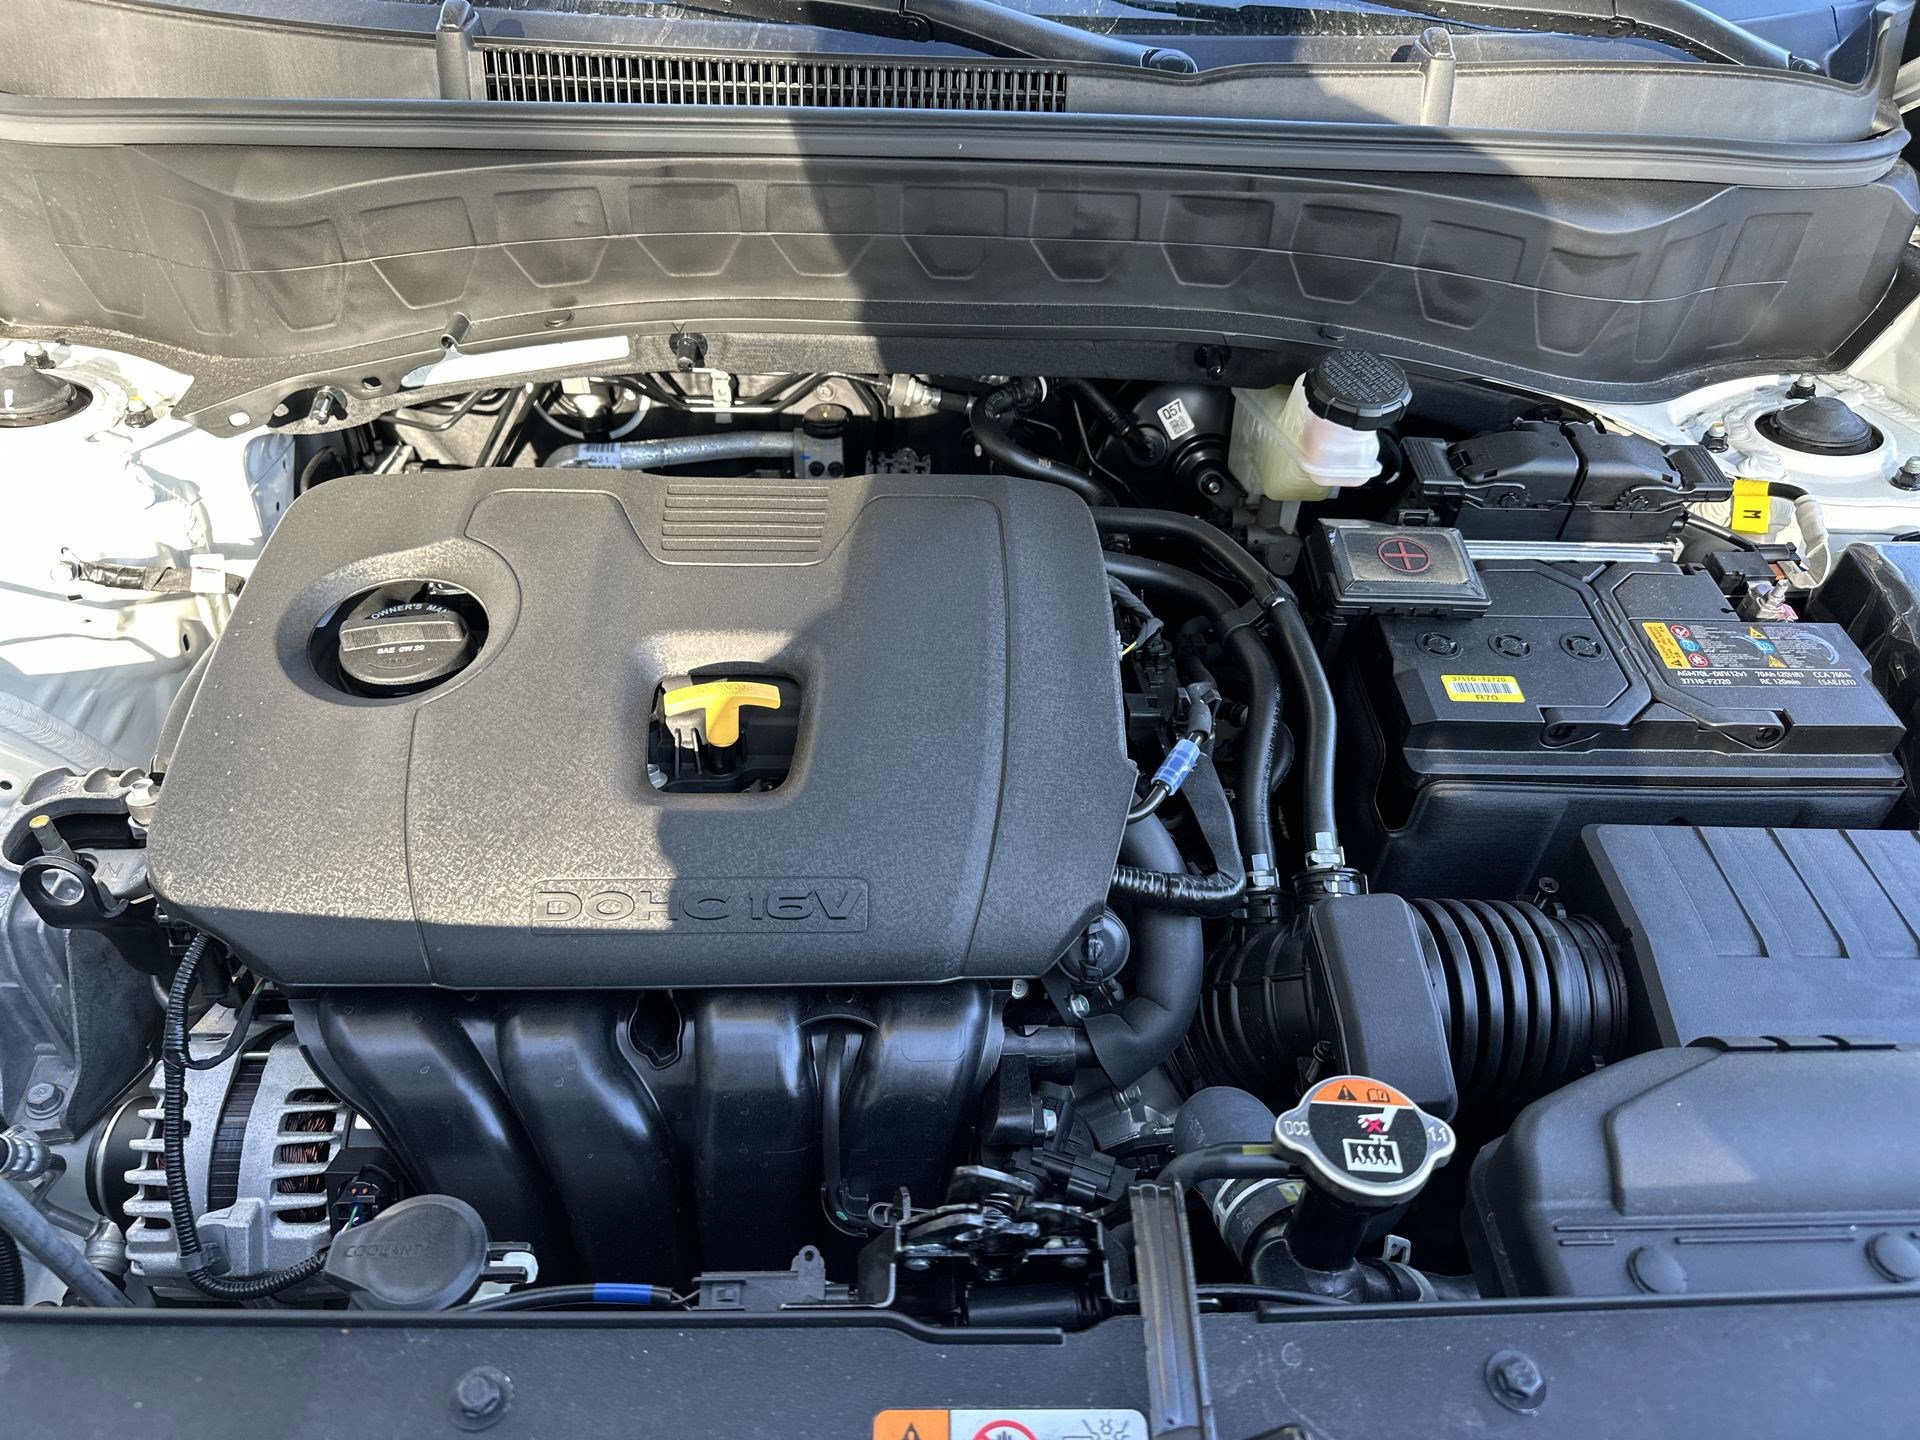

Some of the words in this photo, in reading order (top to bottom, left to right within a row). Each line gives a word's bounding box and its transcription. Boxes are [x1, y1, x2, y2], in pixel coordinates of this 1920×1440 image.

[1162, 401, 1182, 420] Q57
[1743, 509, 1762, 519] M
[371, 603, 423, 620] OWNER'S
[376, 646, 396, 655] SAE
[534, 890, 731, 921] DOHC
[749, 889, 865, 920] 16V
[343, 1243, 424, 1258] COOLANT
